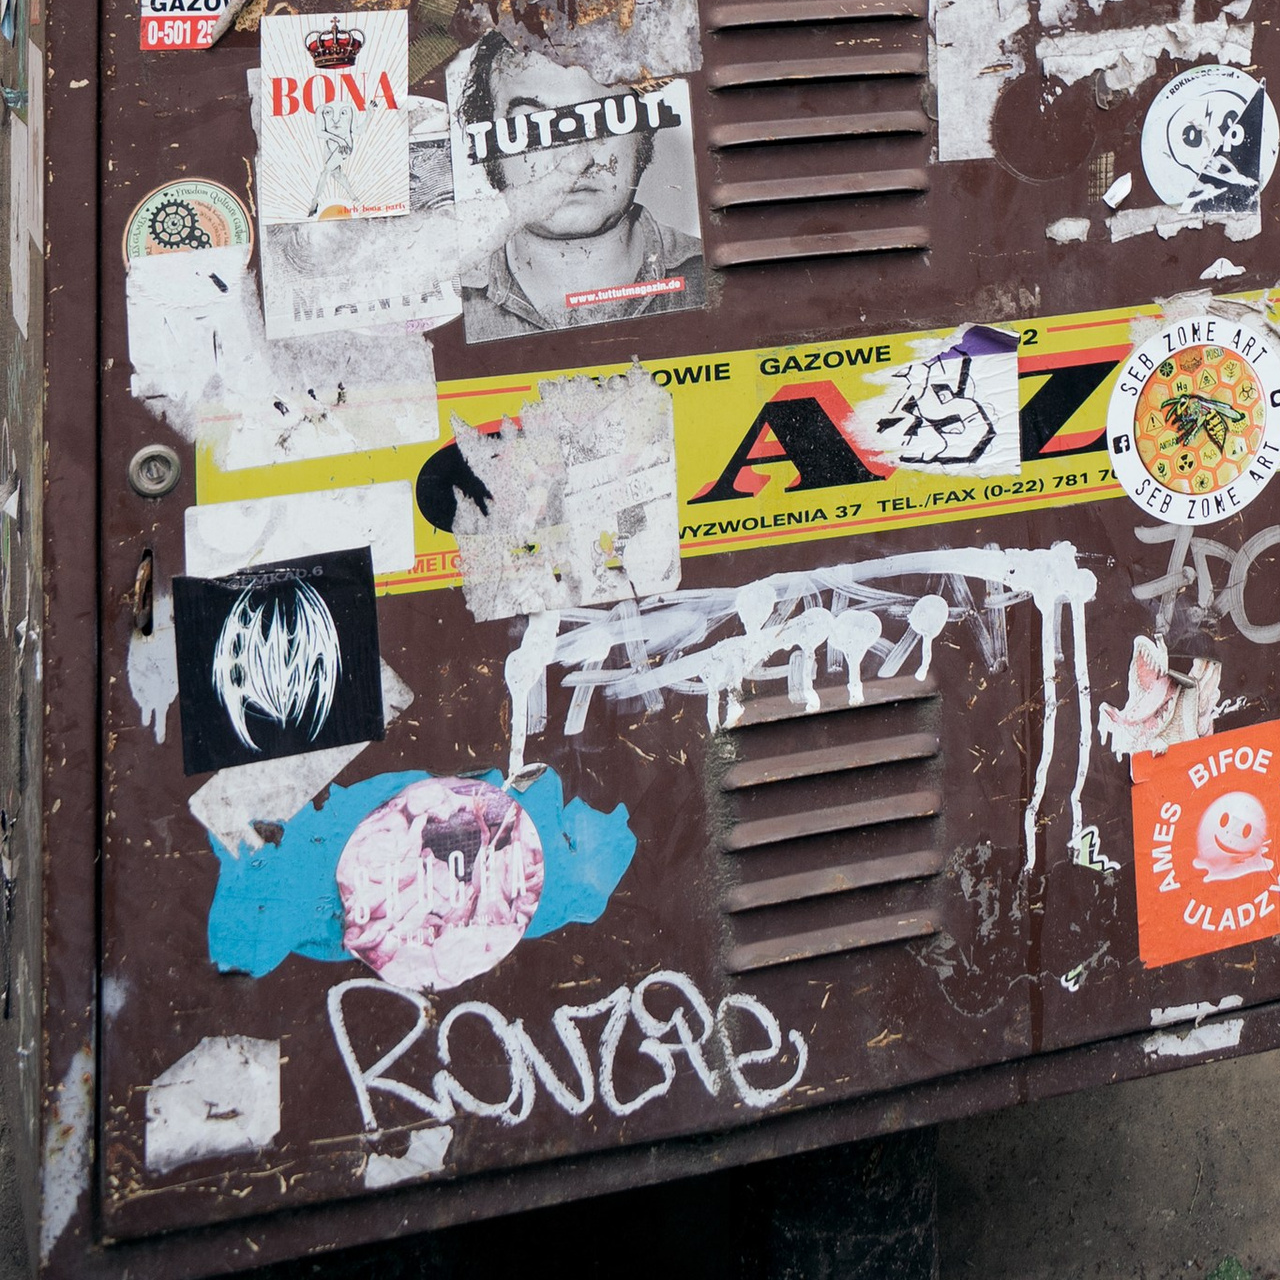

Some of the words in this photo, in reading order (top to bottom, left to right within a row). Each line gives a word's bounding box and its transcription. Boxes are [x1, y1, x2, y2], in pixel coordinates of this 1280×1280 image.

[147, 20, 192, 46] 0-501
[270, 70, 400, 118] BONA
[569, 279, 681, 305] www.tuttutmagazin.de
[759, 344, 891, 376] GAZOWE
[1120, 352, 1155, 397] SEB
[1163, 321, 1216, 353] ZONE
[1231, 328, 1268, 364] ART
[835, 502, 863, 519] 37
[877, 486, 976, 513] TEL./FAX
[983, 477, 1045, 501] (0-22)
[1053, 472, 1089, 489] 781
[1135, 477, 1172, 514] SEB
[1187, 486, 1241, 519] ZONE
[1249, 440, 1280, 485] ART
[1188, 745, 1273, 789] BIFOE
[1151, 801, 1182, 893] AMES
